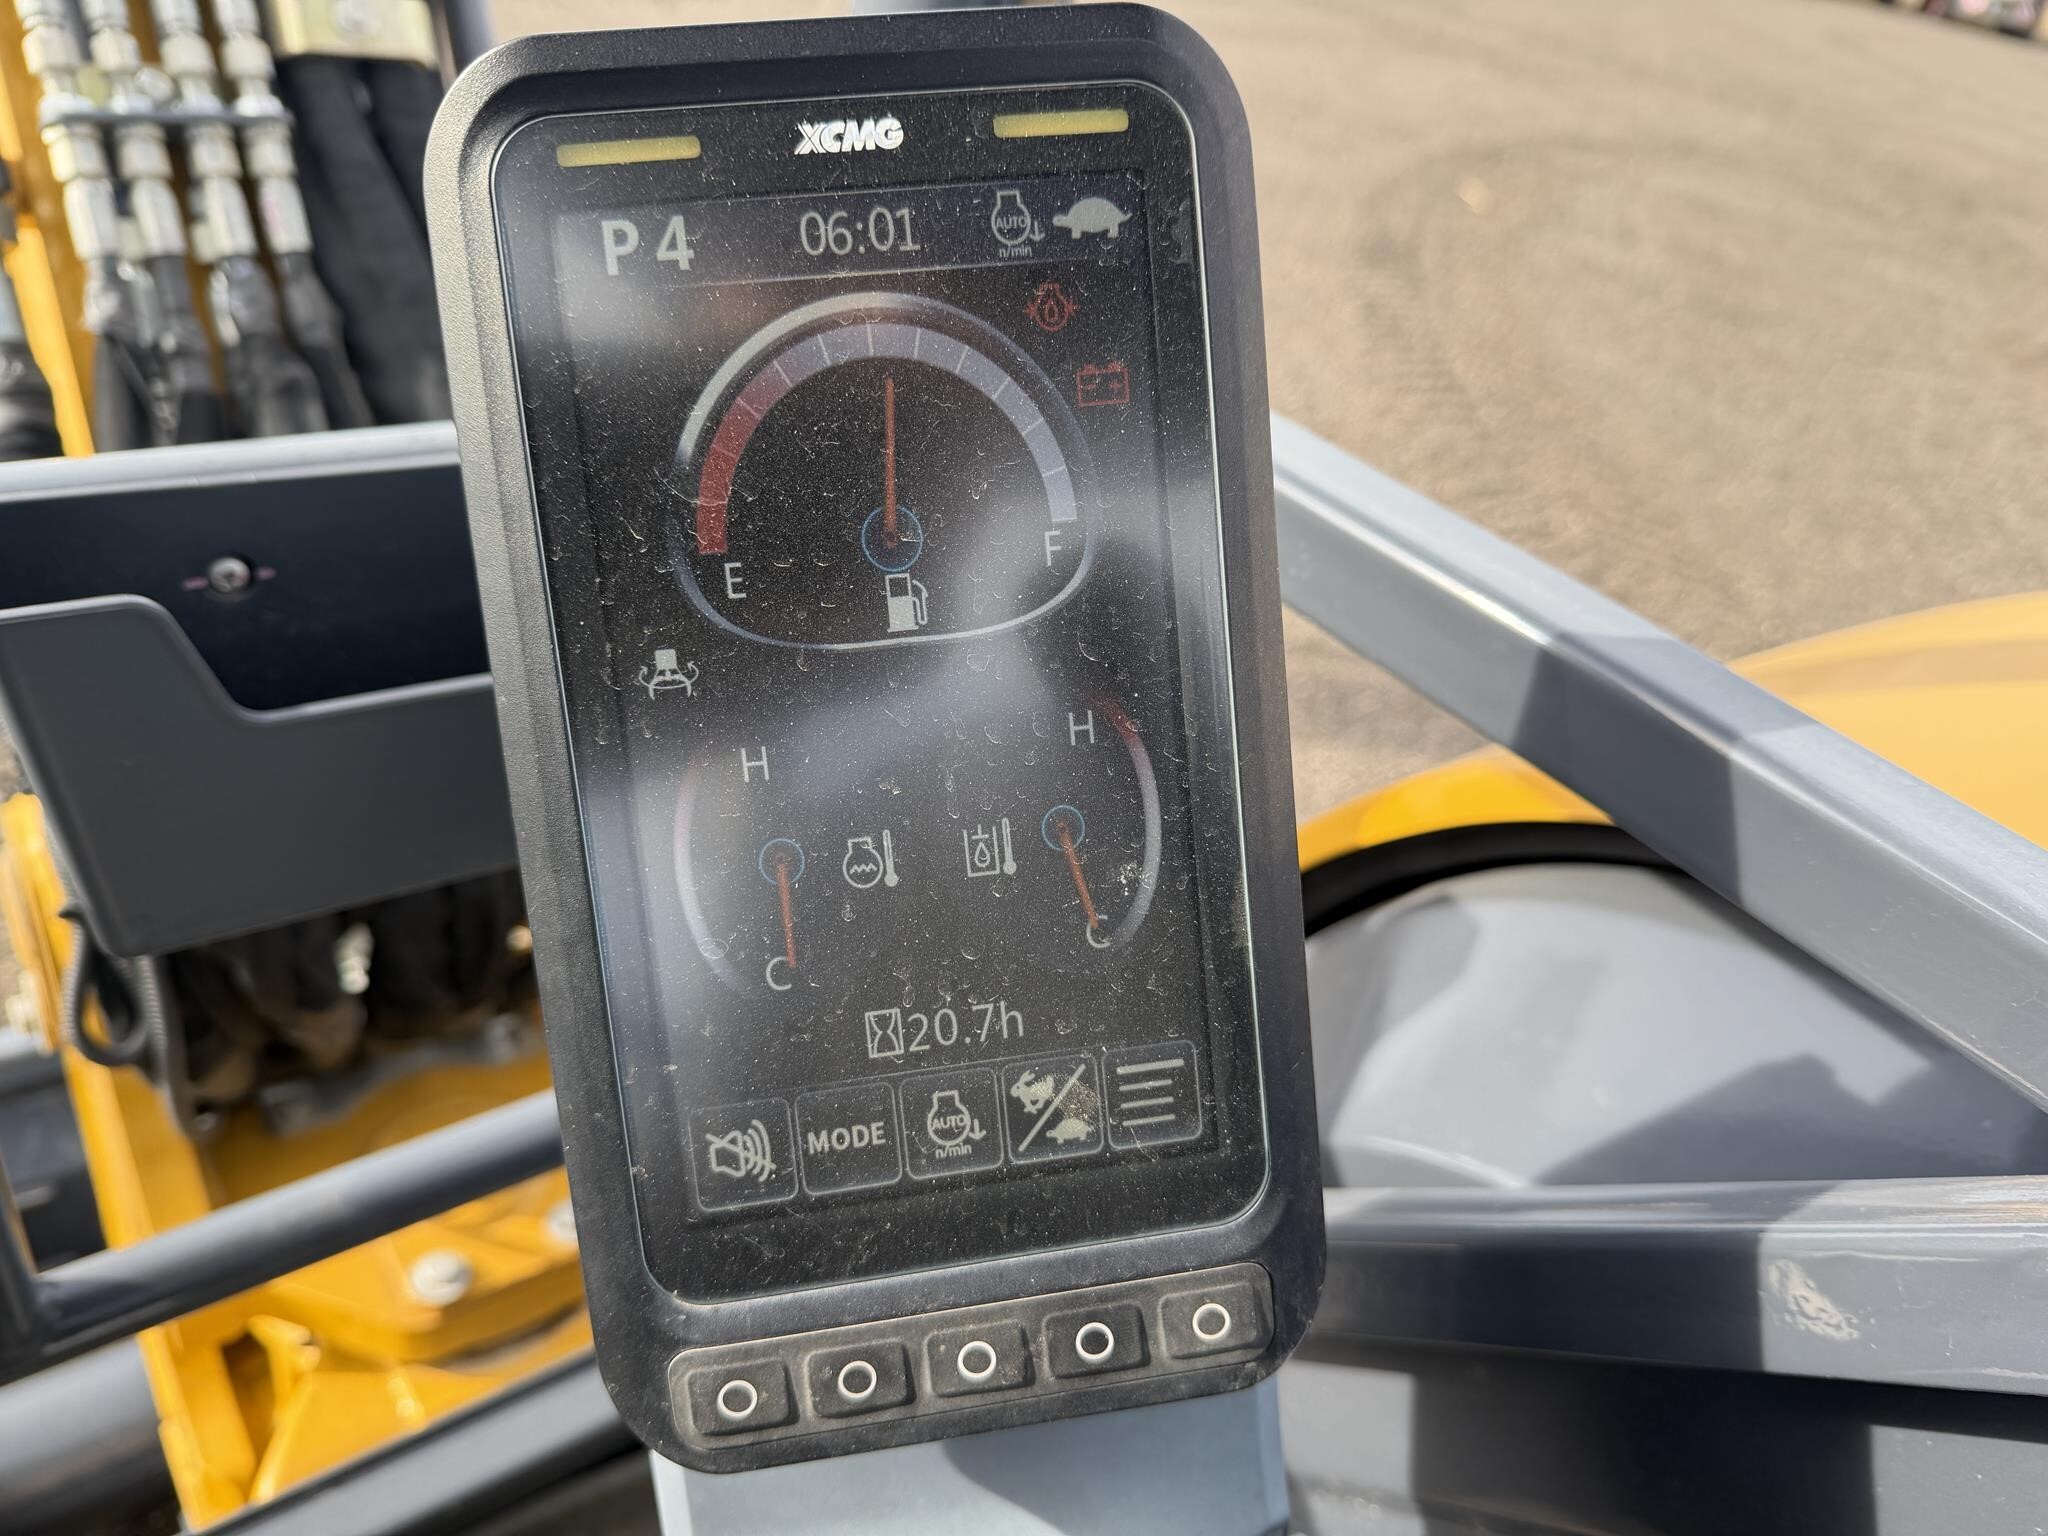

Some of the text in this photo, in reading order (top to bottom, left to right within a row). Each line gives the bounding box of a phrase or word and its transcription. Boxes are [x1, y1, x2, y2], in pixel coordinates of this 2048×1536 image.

[794, 116, 904, 156] XCMG
[799, 206, 921, 257] 06:01
[995, 215, 1028, 231] AUTO
[601, 215, 696, 276] P 4
[999, 245, 1033, 259] n/min
[1043, 530, 1062, 567] F
[724, 562, 747, 599] E
[1068, 710, 1096, 746] H
[740, 746, 770, 783] H
[1086, 914, 1112, 949] C
[765, 956, 793, 991] C
[908, 1001, 1025, 1053] 20.7h
[807, 1121, 887, 1156] MODE
[931, 1114, 968, 1132] AUTO
[935, 1142, 973, 1160] n/min
